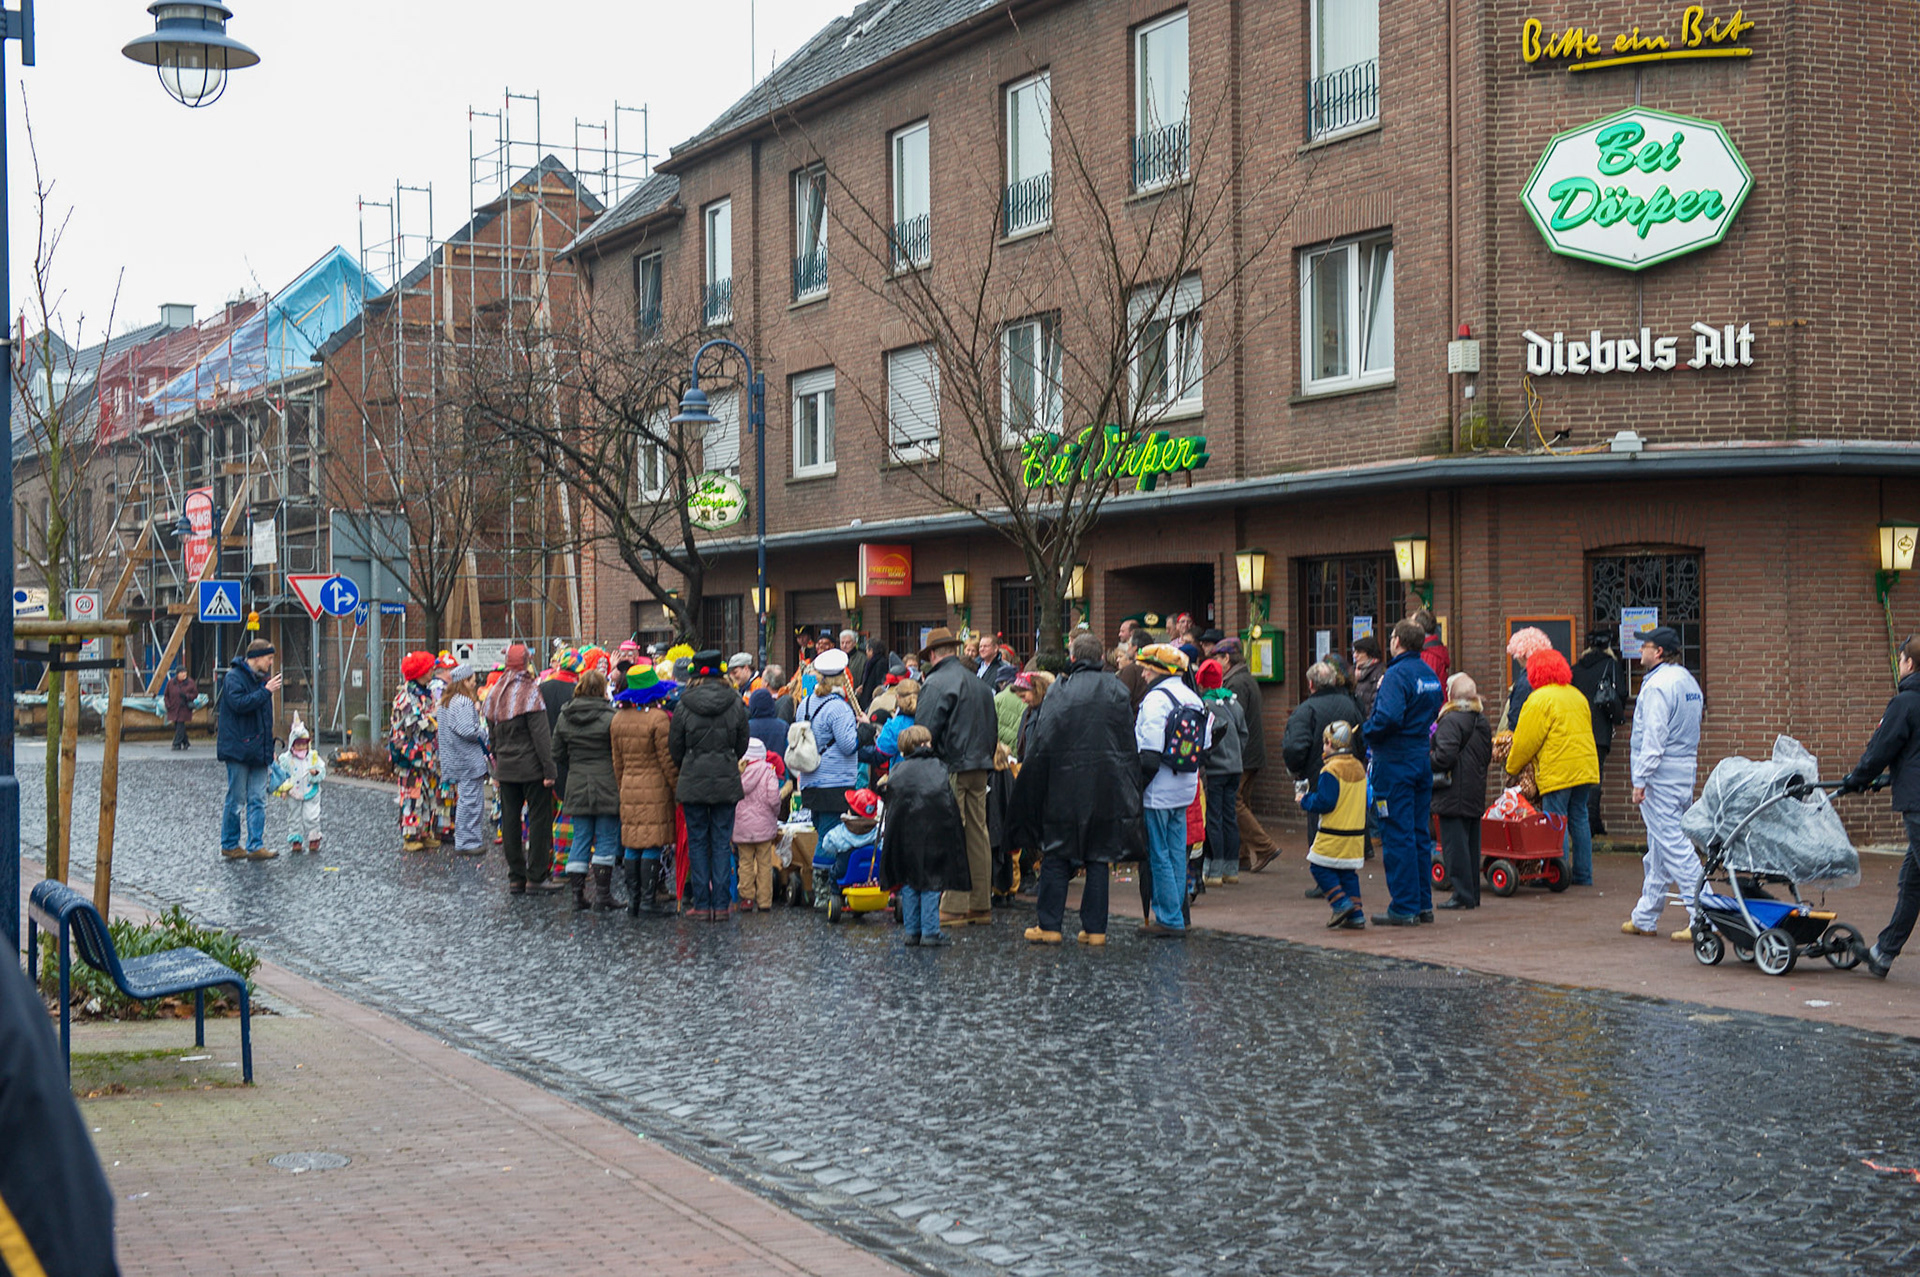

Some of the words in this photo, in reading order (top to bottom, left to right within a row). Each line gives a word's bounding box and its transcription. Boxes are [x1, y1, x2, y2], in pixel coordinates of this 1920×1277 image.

[1522, 18, 1601, 63] Bitte
[1612, 27, 1670, 53] ein
[1681, 5, 1754, 48] Bit
[1595, 121, 1685, 176] Bei
[1548, 176, 1726, 239] Dörper
[1687, 321, 1755, 370] Alt
[687, 493, 737, 511] Dörper
[701, 479, 727, 494] Bei
[79, 600, 91, 609] 20
